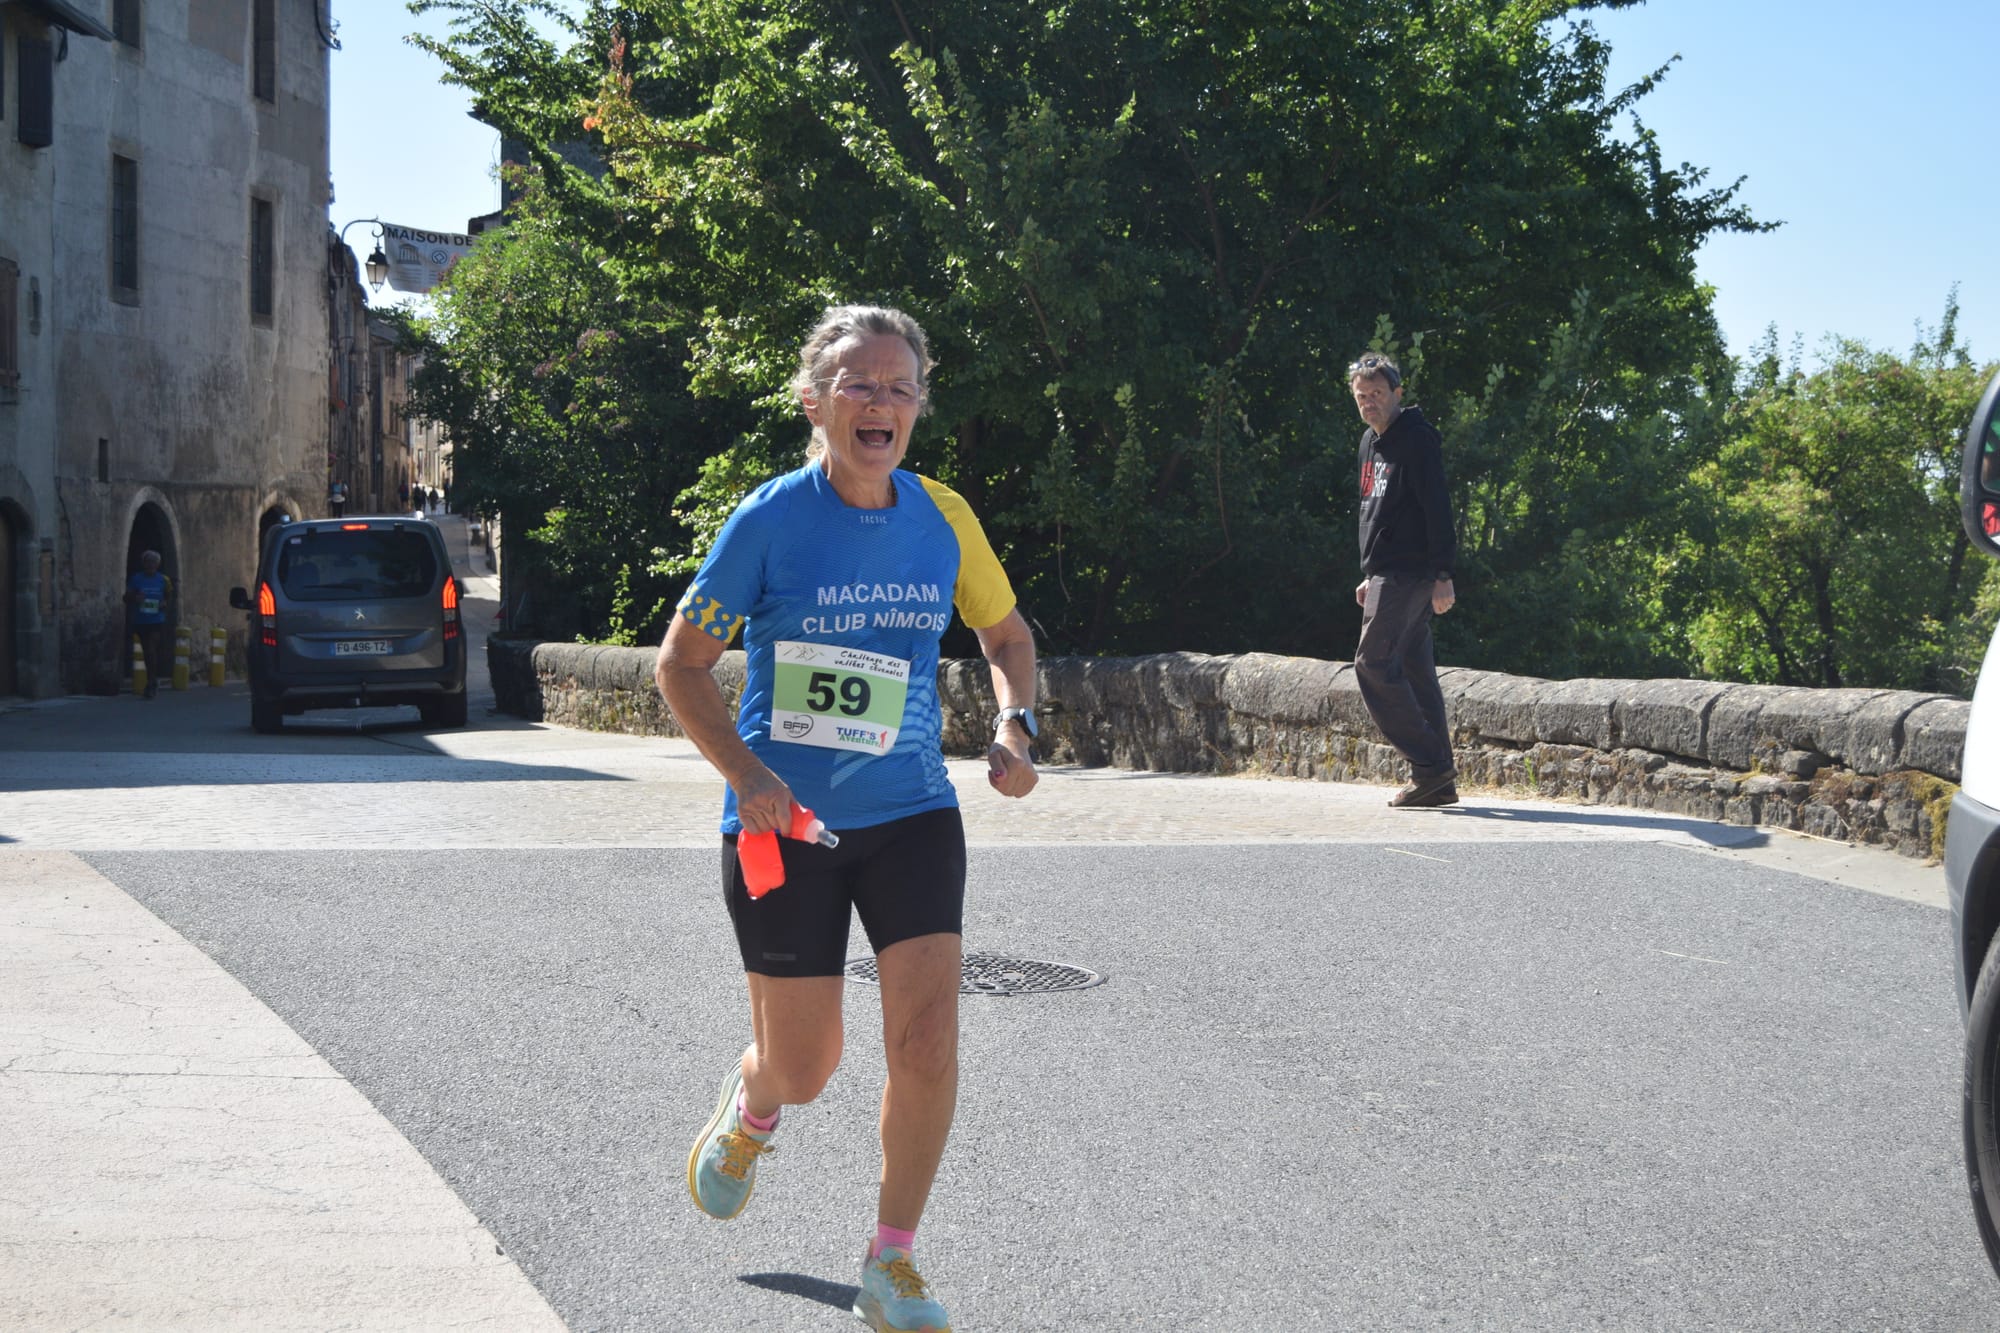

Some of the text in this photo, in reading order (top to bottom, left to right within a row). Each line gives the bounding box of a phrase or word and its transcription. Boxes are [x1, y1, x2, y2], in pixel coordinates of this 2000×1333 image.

[387, 227, 473, 247] MAISON DE
[817, 583, 940, 606] MACADAM
[802, 607, 946, 634] CLUB NÎMOIS
[834, 659, 865, 669] vallées
[840, 650, 901, 669] Challenge des
[806, 671, 871, 717] 59
[783, 720, 809, 731] BFP
[836, 726, 877, 741] TUFF'S
